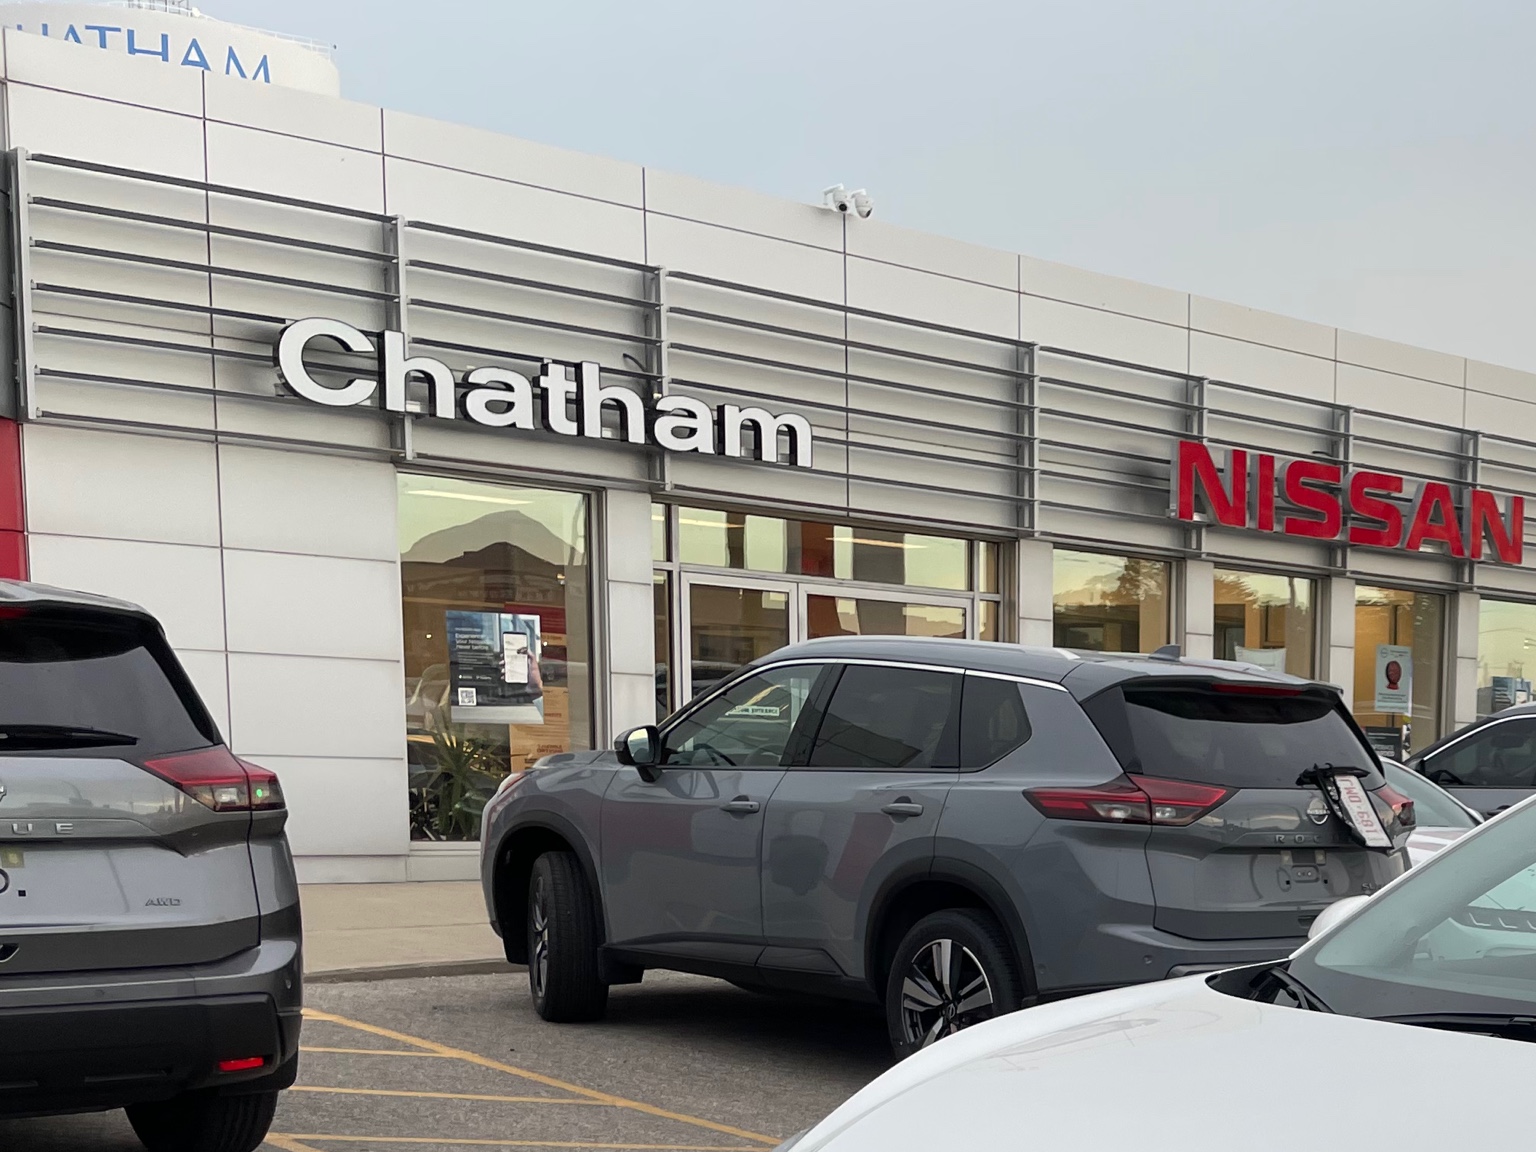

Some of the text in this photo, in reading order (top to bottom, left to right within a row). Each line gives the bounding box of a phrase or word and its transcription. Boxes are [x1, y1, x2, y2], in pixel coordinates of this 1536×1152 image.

[275, 316, 813, 469] Chatham
[1173, 439, 1525, 566] NISSAN
[145, 897, 182, 906] AWD
